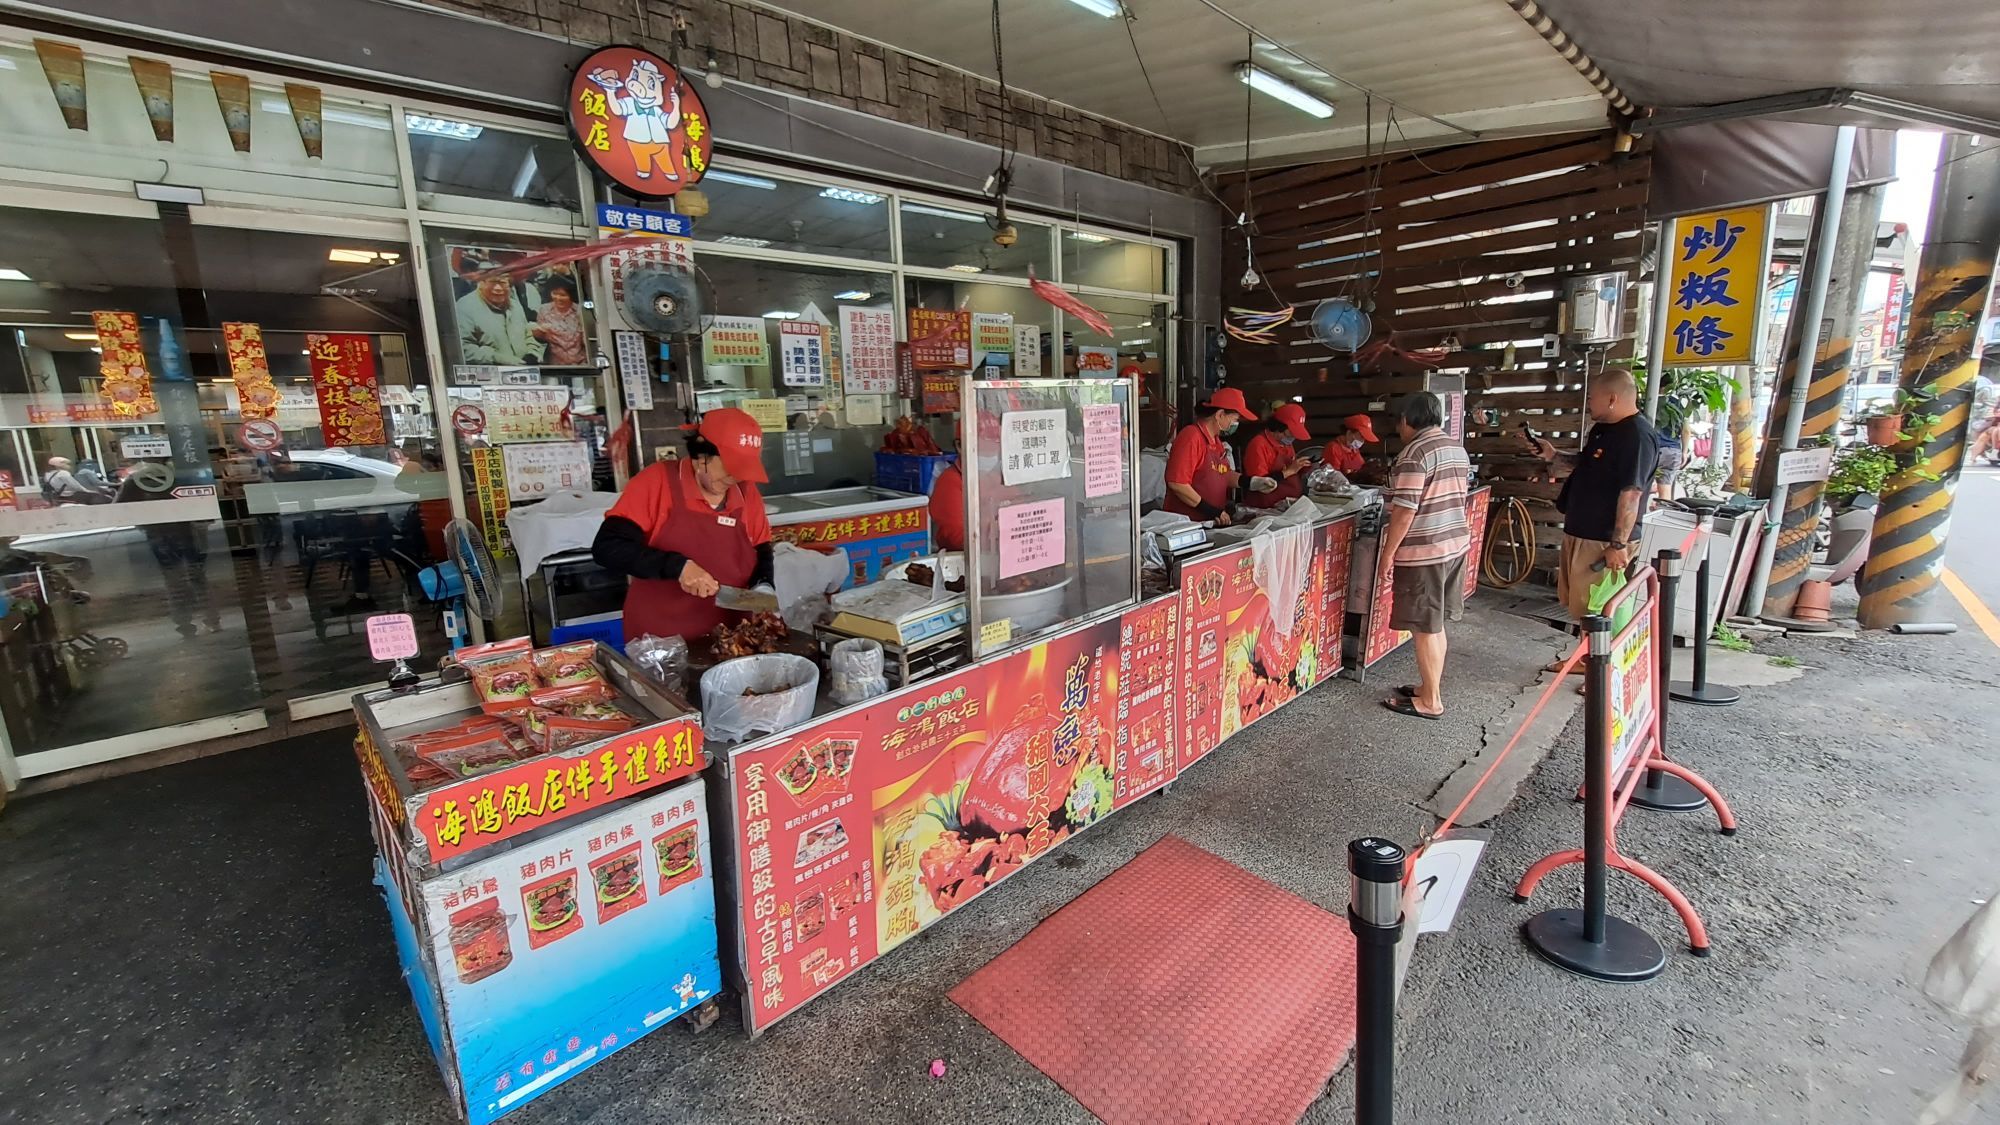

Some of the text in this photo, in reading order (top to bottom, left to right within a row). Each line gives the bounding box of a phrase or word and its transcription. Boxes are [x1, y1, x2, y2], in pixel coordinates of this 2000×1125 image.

[579, 88, 611, 151] 飯店
[605, 209, 682, 233] 敬告顧客
[1673, 219, 1745, 356] 炒粄條
[316, 342, 352, 427] 迎春接福
[1012, 418, 1055, 432] 親愛的顧客
[1009, 450, 1060, 470] 請戴口罩
[881, 699, 981, 751] 海鴻飯店
[1115, 624, 1133, 800] 總統蒞臨指定店
[433, 727, 694, 846] 海鴻飯店伴手禮系列
[587, 824, 634, 854] 豬肉條
[651, 799, 696, 828] 豬肉角
[520, 848, 574, 880] 豬肉片
[744, 762, 784, 1009] 享用御膳級的古早風味
[883, 807, 918, 942] 海鴻豬腳
[443, 877, 499, 910] 豬肉鬆
